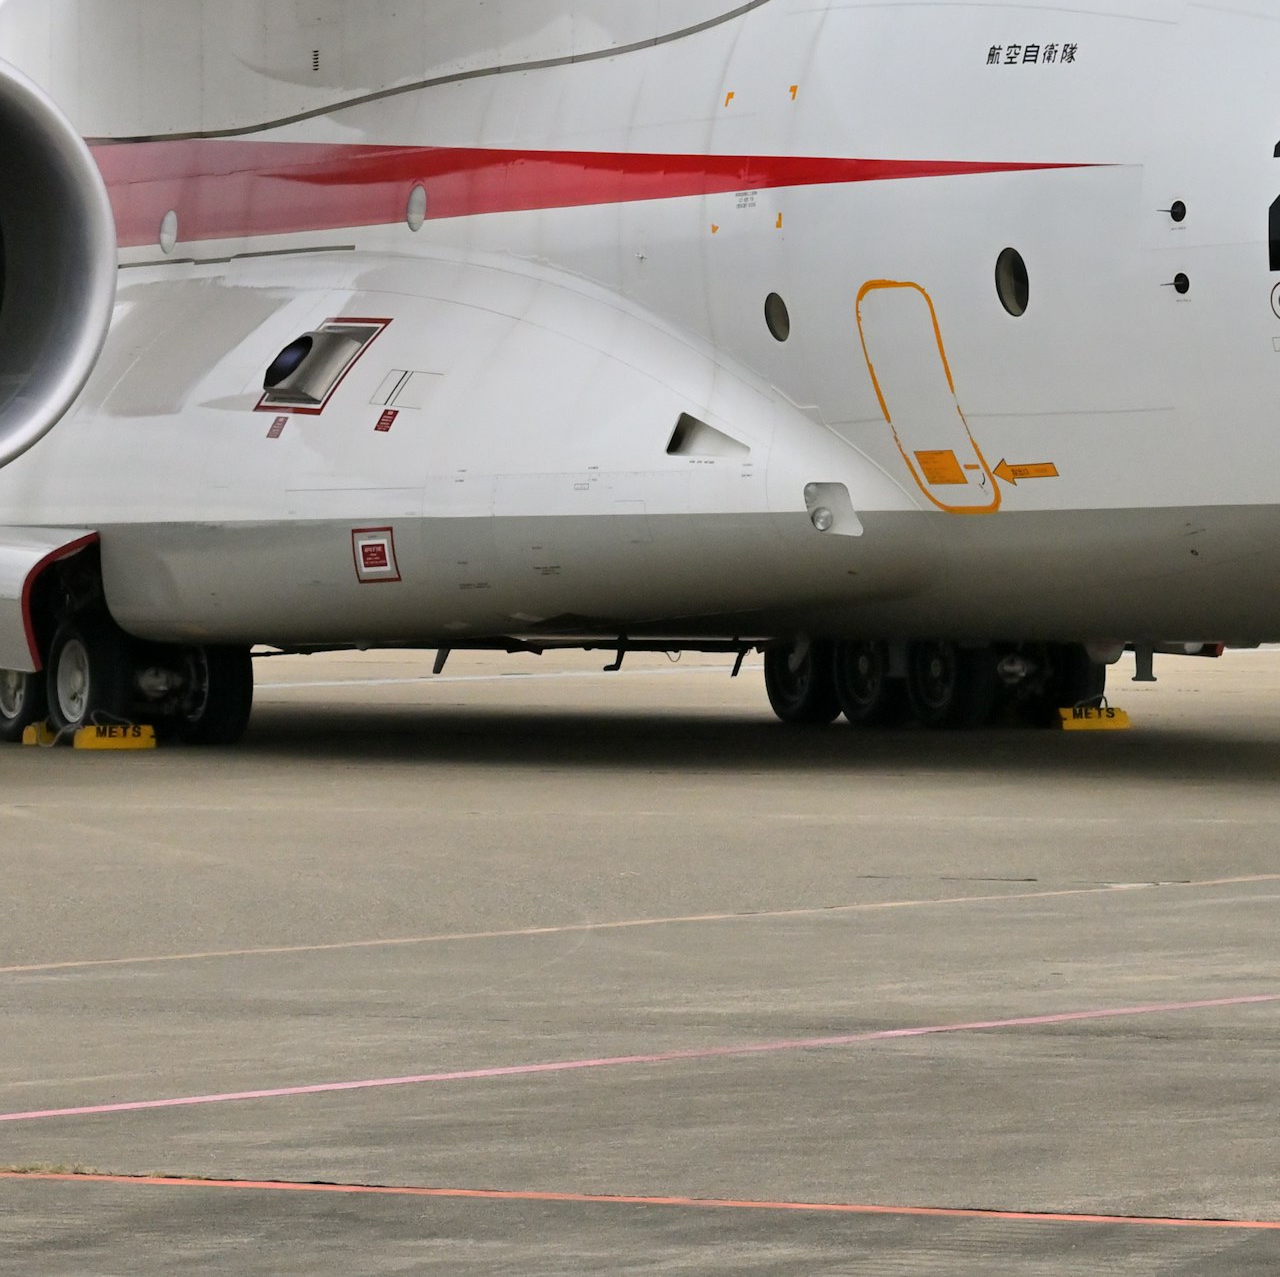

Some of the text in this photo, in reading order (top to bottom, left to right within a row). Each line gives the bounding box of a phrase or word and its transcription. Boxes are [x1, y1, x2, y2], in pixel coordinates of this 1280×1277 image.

[986, 43, 1078, 65] 航空自衛隊
[1072, 708, 1115, 720] METS
[96, 726, 142, 738] METS
